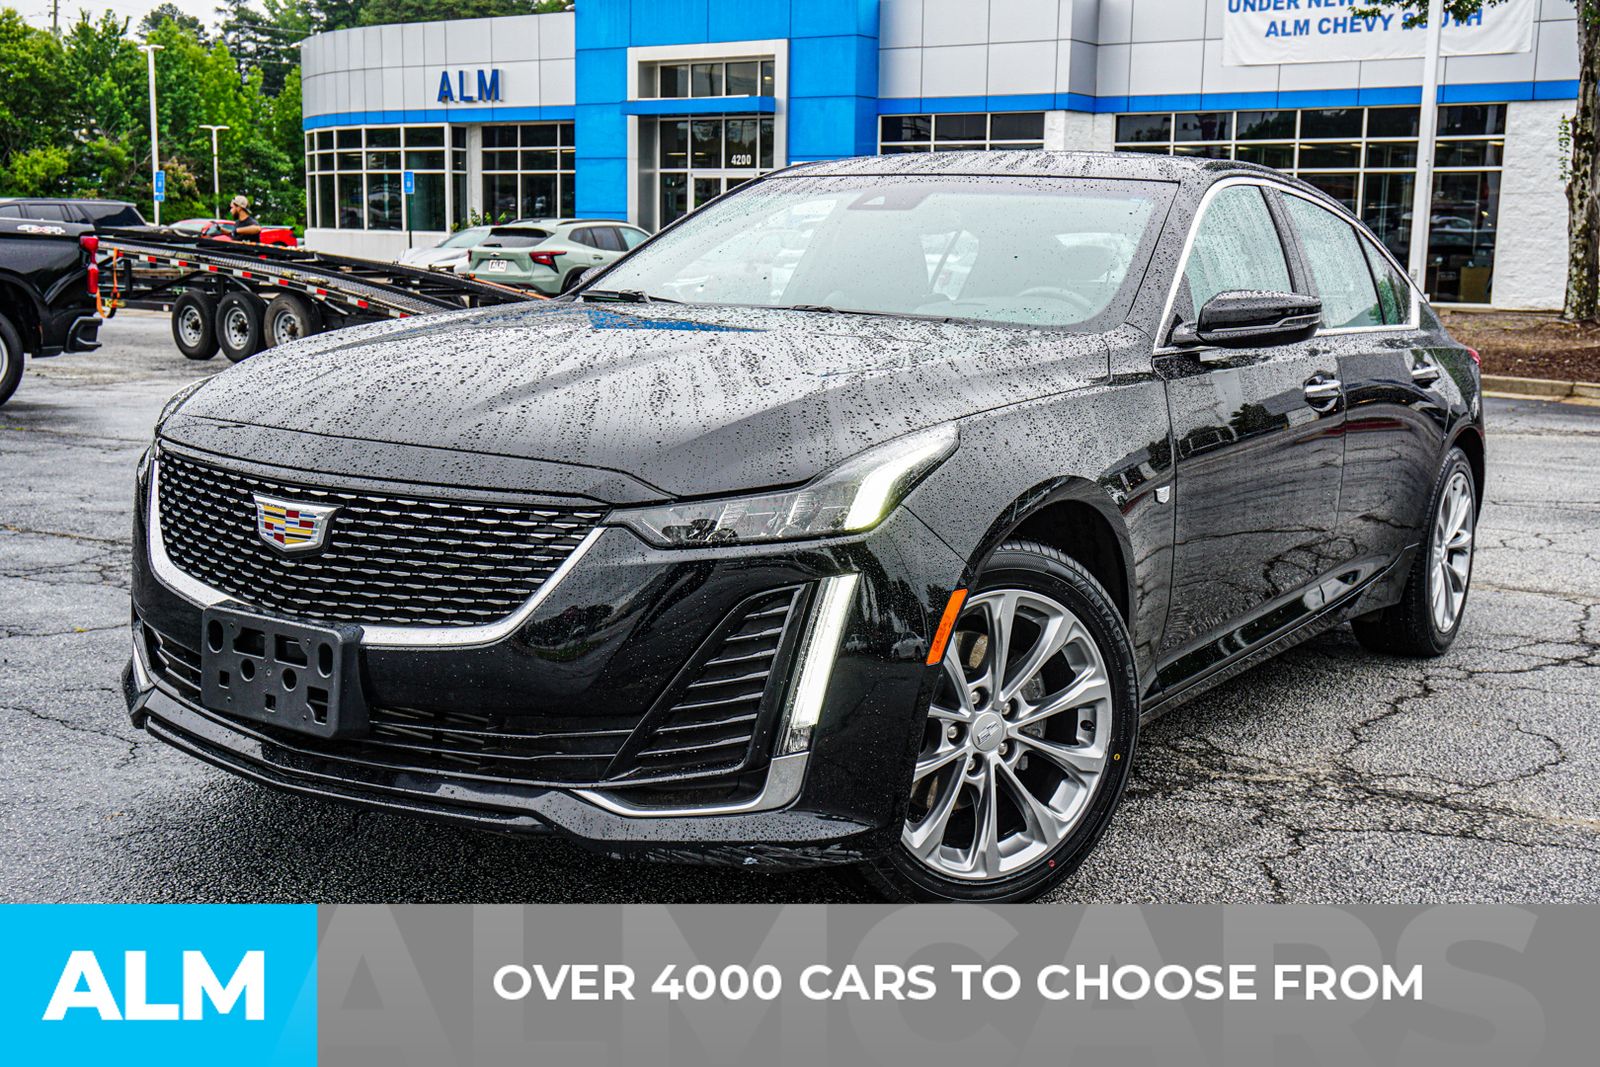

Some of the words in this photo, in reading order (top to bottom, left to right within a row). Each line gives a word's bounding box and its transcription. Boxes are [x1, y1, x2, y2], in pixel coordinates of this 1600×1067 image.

[1228, 0, 1300, 13] UNDER
[1265, 19, 1310, 38] ALM
[1317, 13, 1394, 35] CHEVY
[437, 69, 500, 102] ALM
[730, 154, 752, 166] 4200
